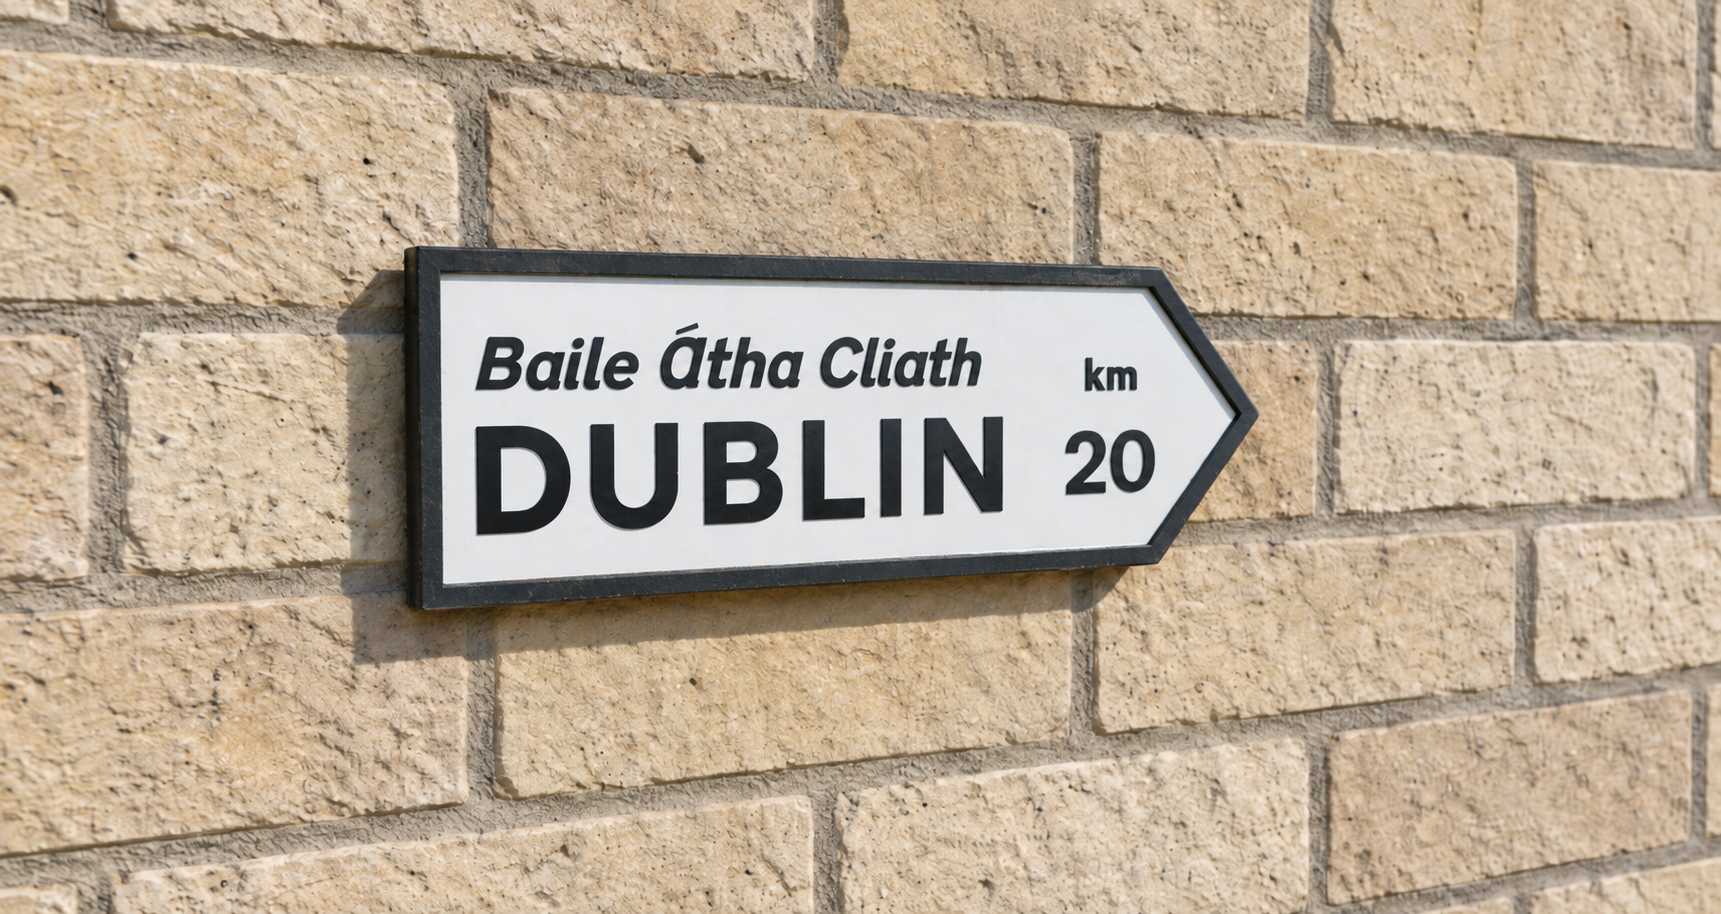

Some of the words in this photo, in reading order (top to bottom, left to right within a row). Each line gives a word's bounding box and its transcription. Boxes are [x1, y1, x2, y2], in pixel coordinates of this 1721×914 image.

[475, 336, 640, 392] Baile
[819, 337, 982, 390] Cliath
[1084, 357, 1138, 392] km
[475, 416, 1004, 536] DUBLIN
[1064, 429, 1156, 496] 20
